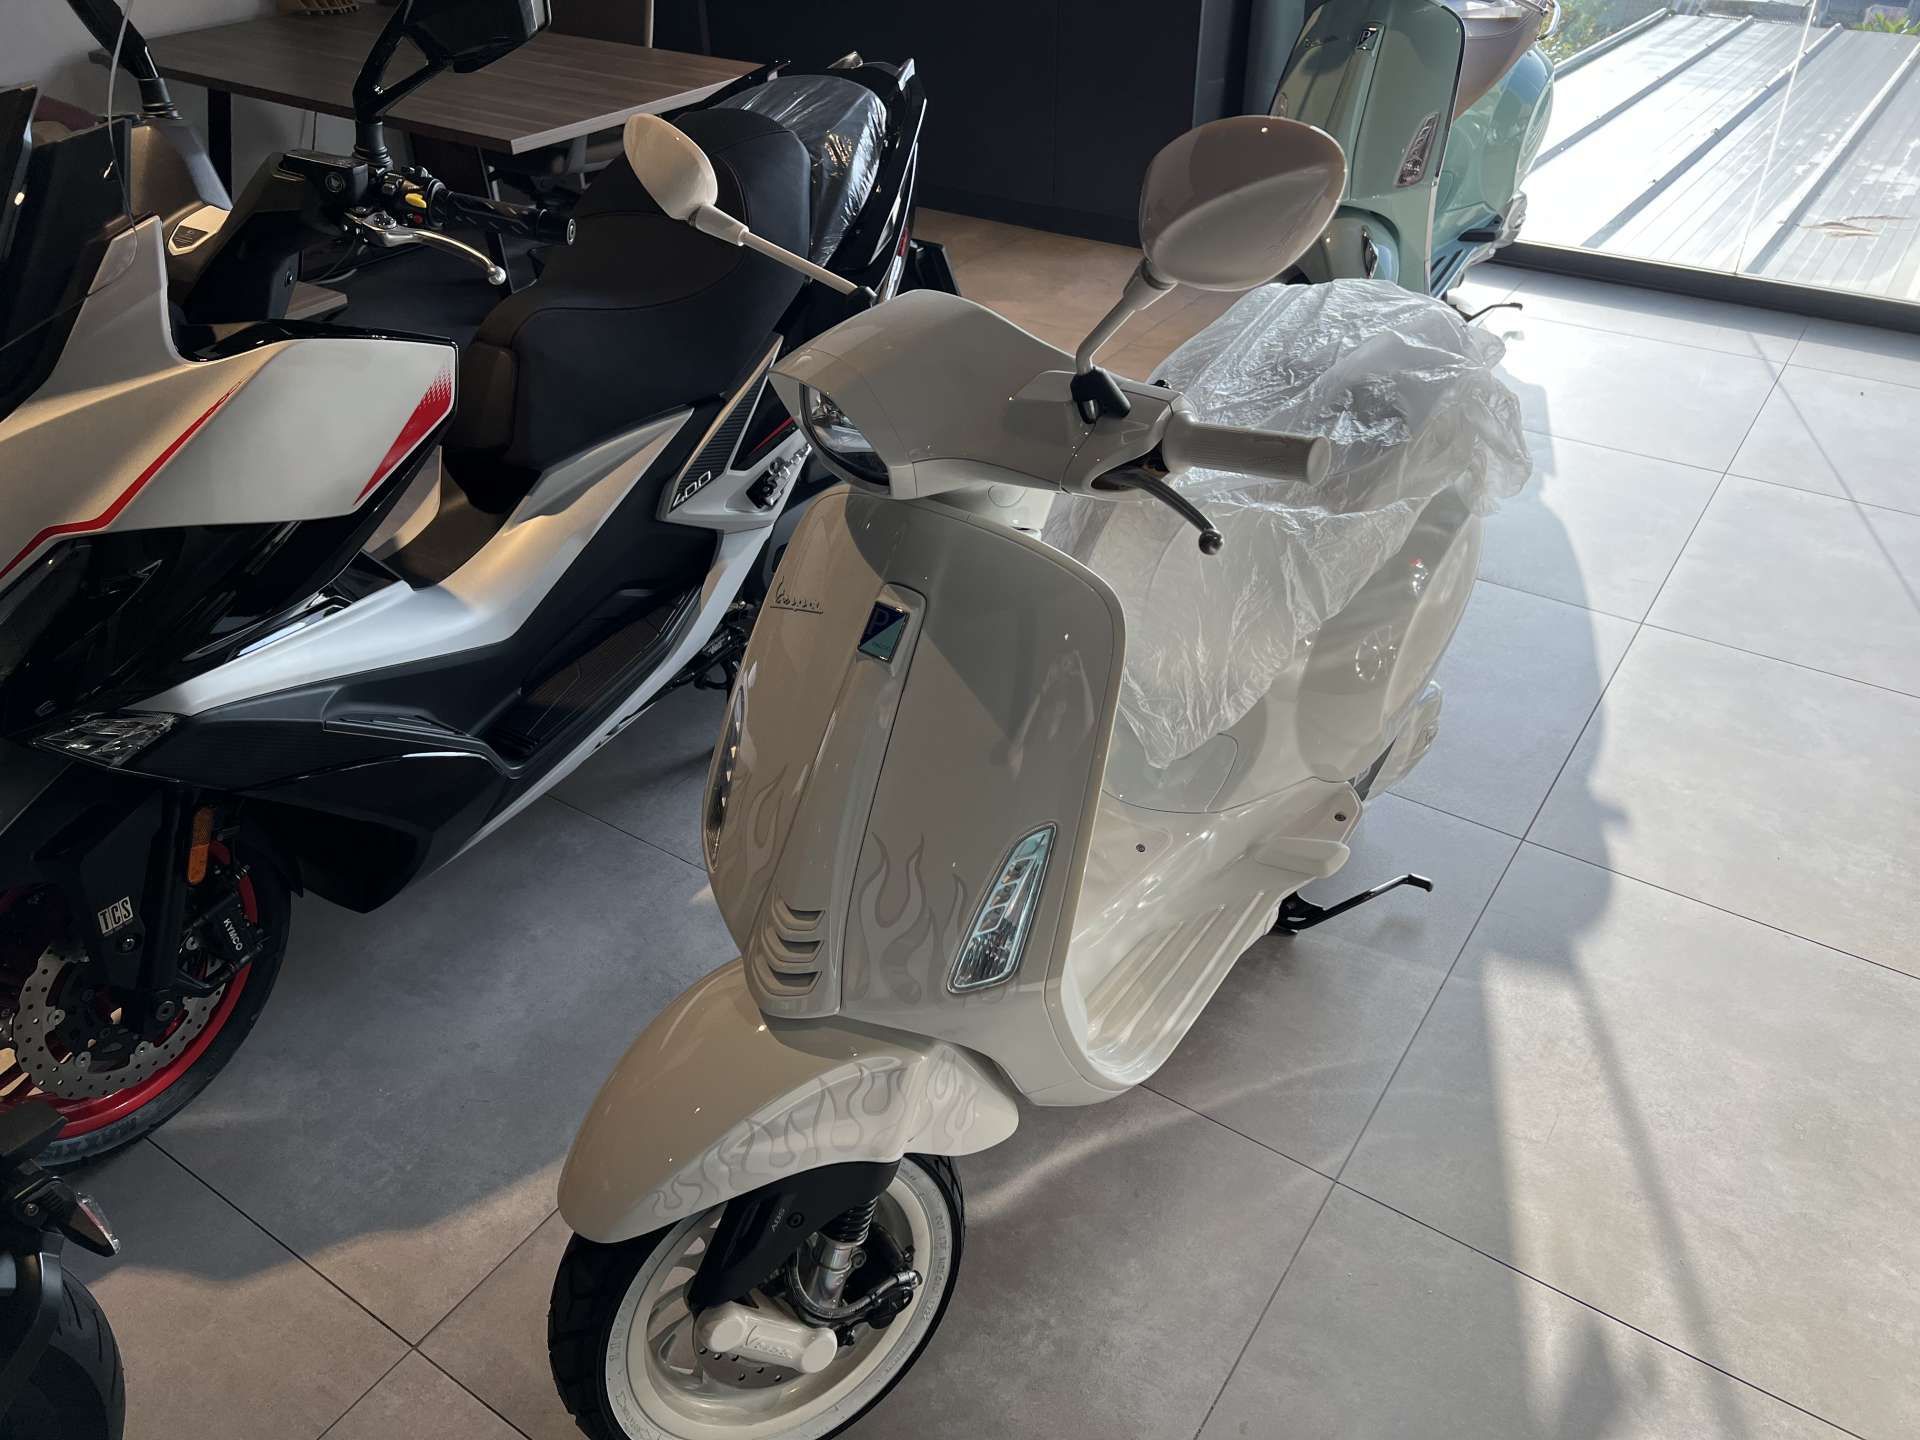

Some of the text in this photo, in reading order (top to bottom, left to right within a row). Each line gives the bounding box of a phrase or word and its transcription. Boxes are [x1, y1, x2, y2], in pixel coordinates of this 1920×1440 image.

[672, 470, 712, 507] 400
[99, 898, 132, 932] TCS
[223, 918, 244, 951] KYMCO
